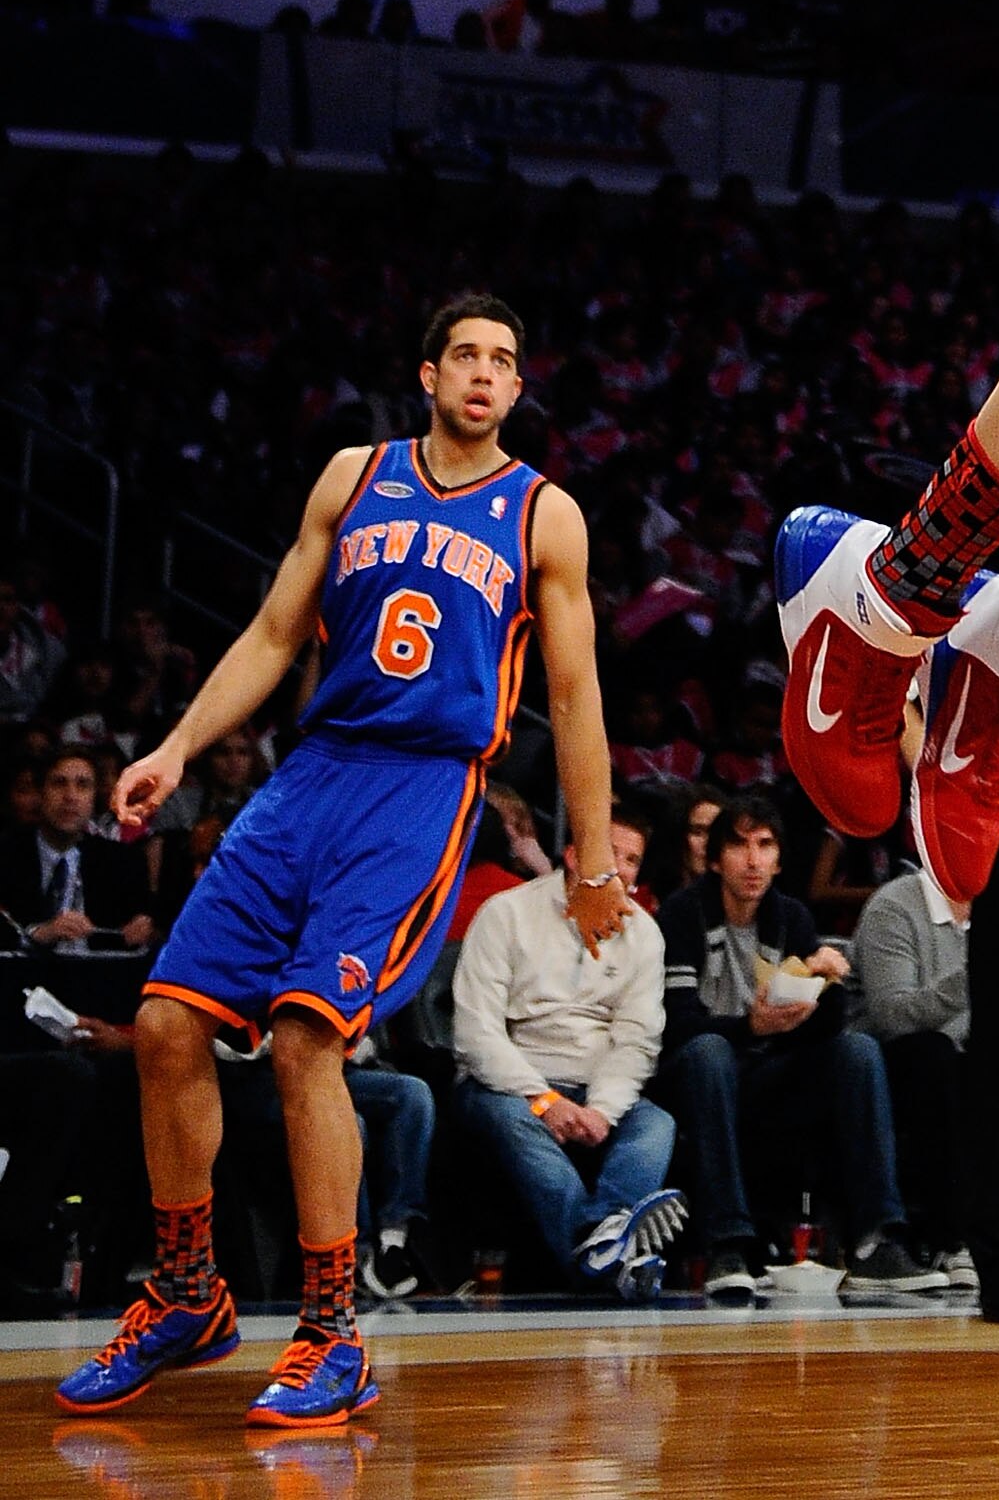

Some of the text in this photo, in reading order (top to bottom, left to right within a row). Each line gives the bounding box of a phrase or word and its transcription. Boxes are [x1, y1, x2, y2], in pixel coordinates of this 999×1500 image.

[336, 520, 516, 618] NEW YORK
[371, 587, 442, 681] 6
